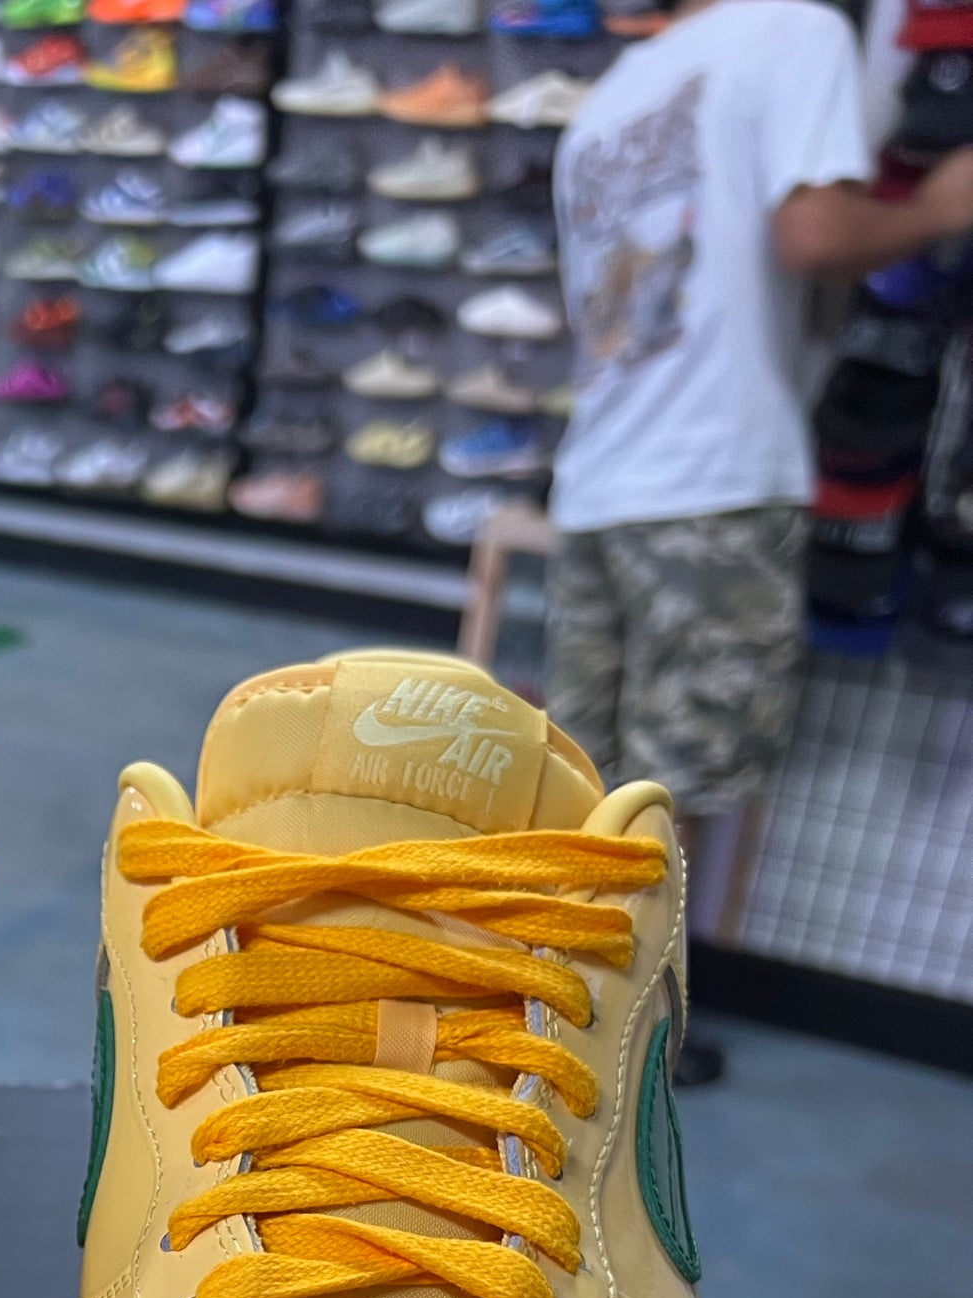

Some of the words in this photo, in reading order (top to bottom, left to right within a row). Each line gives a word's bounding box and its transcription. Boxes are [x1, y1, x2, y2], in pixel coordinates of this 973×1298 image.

[381, 677, 487, 726] NIKE
[349, 752, 389, 786] AIR
[402, 760, 474, 801] FORCE
[438, 733, 514, 785] AIR
